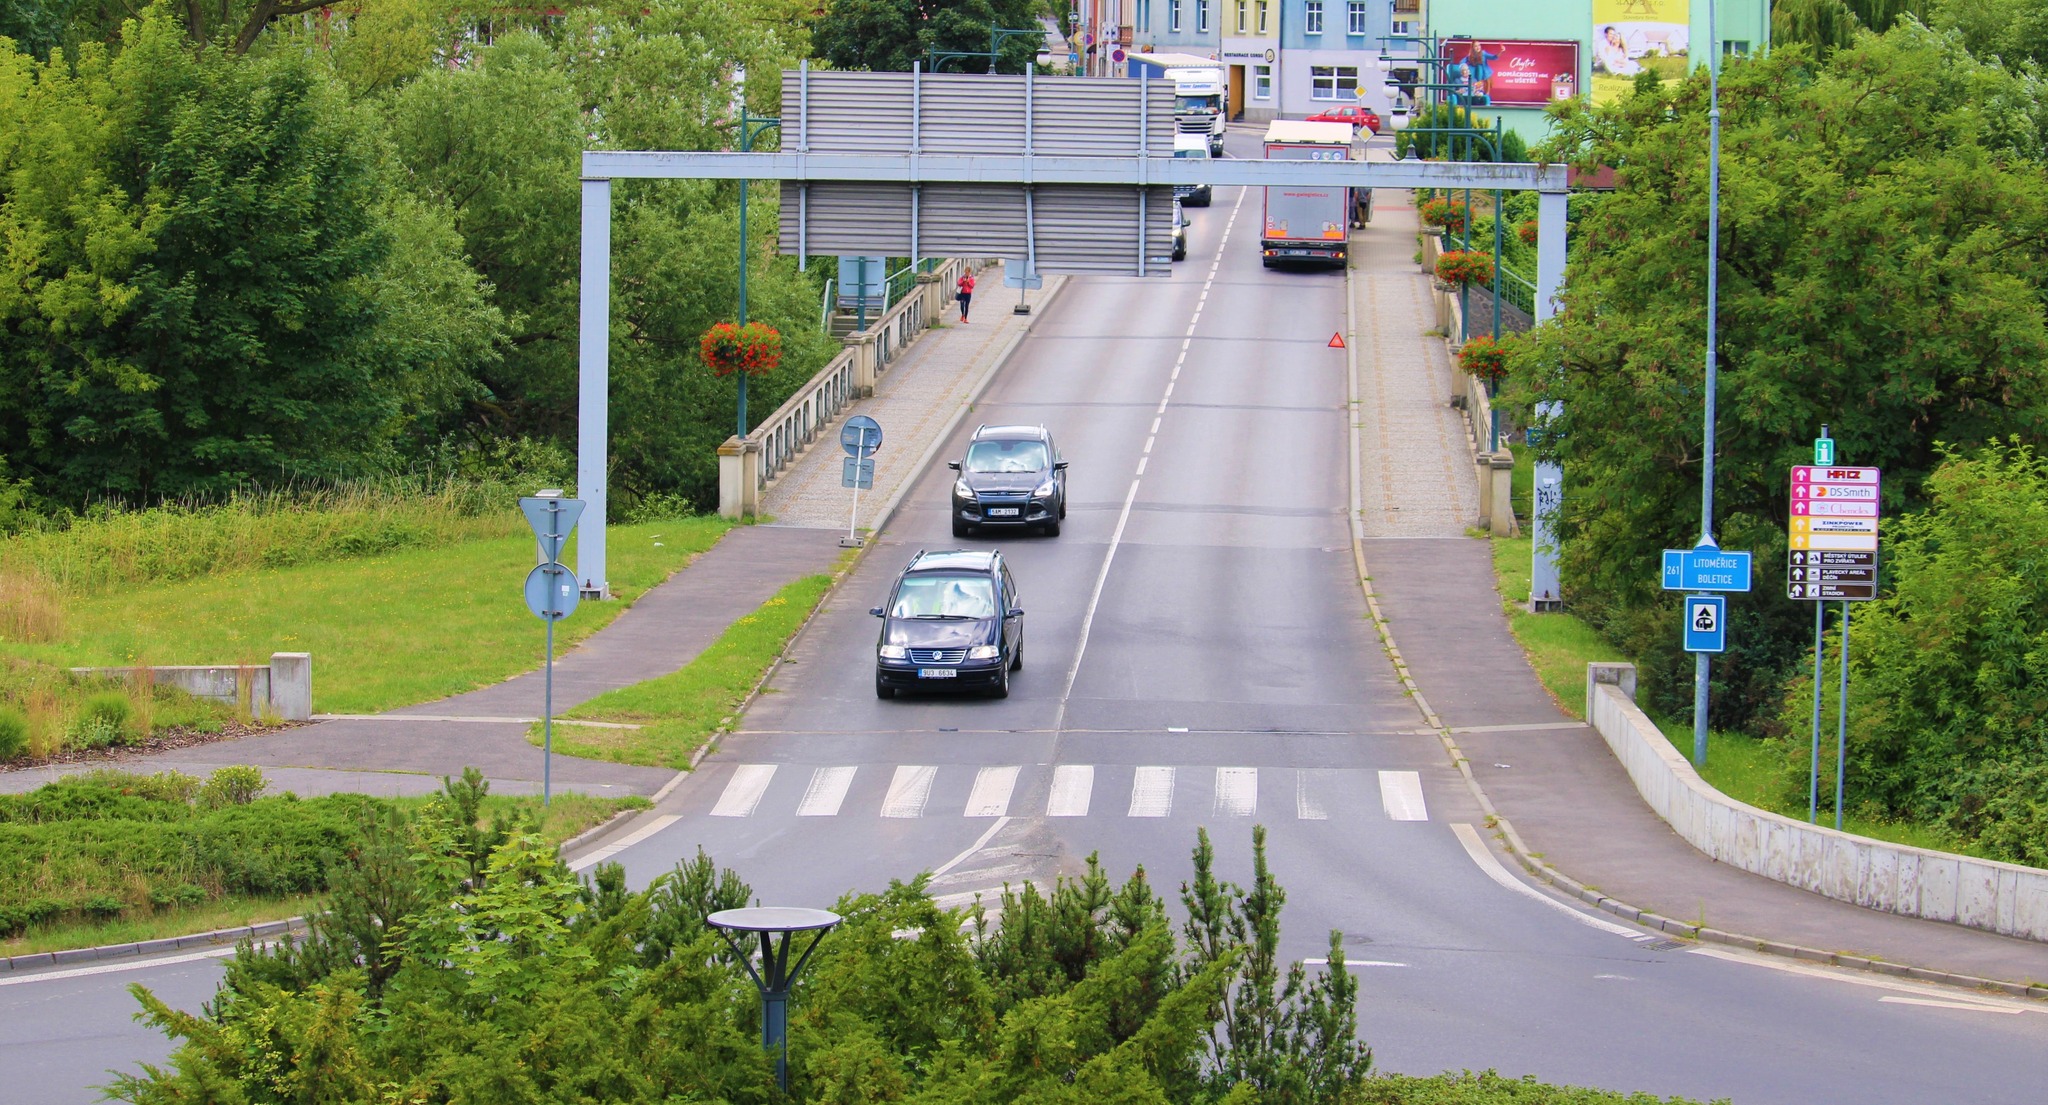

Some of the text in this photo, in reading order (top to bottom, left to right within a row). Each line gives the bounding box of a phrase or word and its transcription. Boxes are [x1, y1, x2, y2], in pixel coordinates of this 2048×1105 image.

[1509, 57, 1536, 71] Chytré
[1830, 487, 1870, 497] DS Smith
[1693, 557, 1738, 569] LITOMĚŘICE
[1666, 565, 1680, 575] 261
[1697, 574, 1733, 584] BOLETICE
